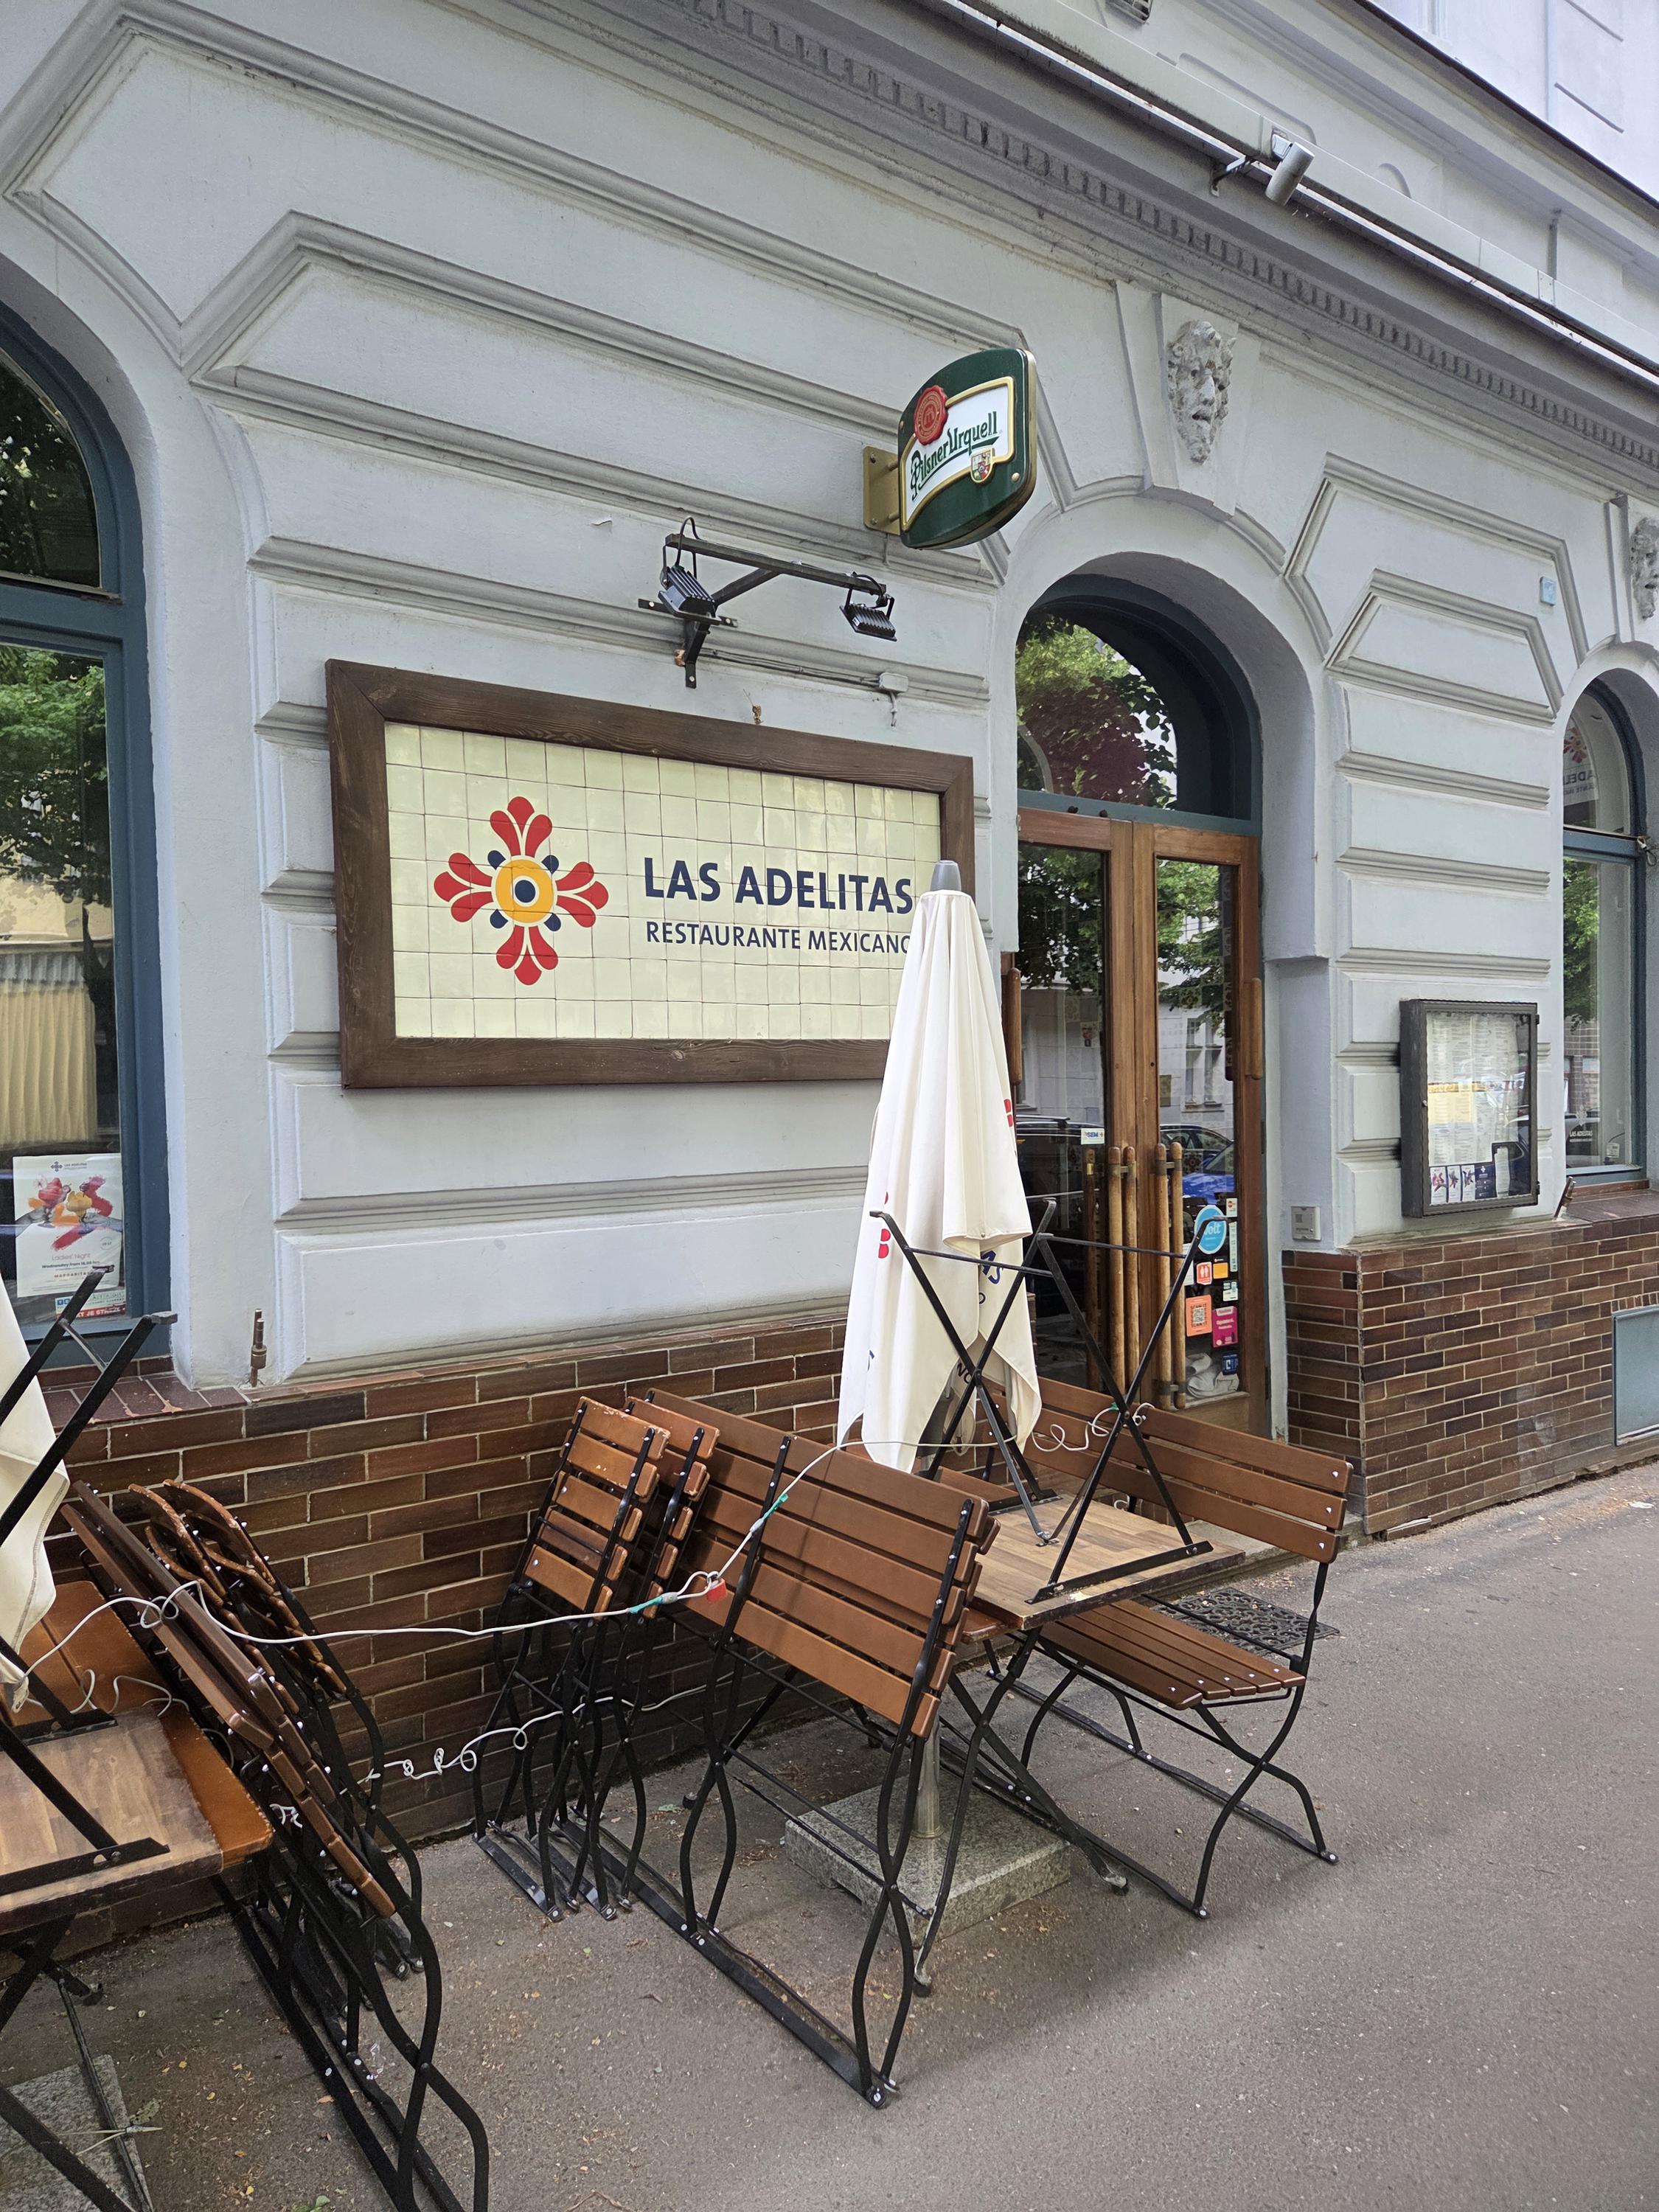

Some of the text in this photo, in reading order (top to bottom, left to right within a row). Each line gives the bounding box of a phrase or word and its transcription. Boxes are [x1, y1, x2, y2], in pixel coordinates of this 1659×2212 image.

[910, 441, 950, 502] Pilsner
[947, 411, 998, 456] Urquell
[644, 857, 913, 915] LAS ADELITAS
[646, 921, 801, 950] RESTAURANTE
